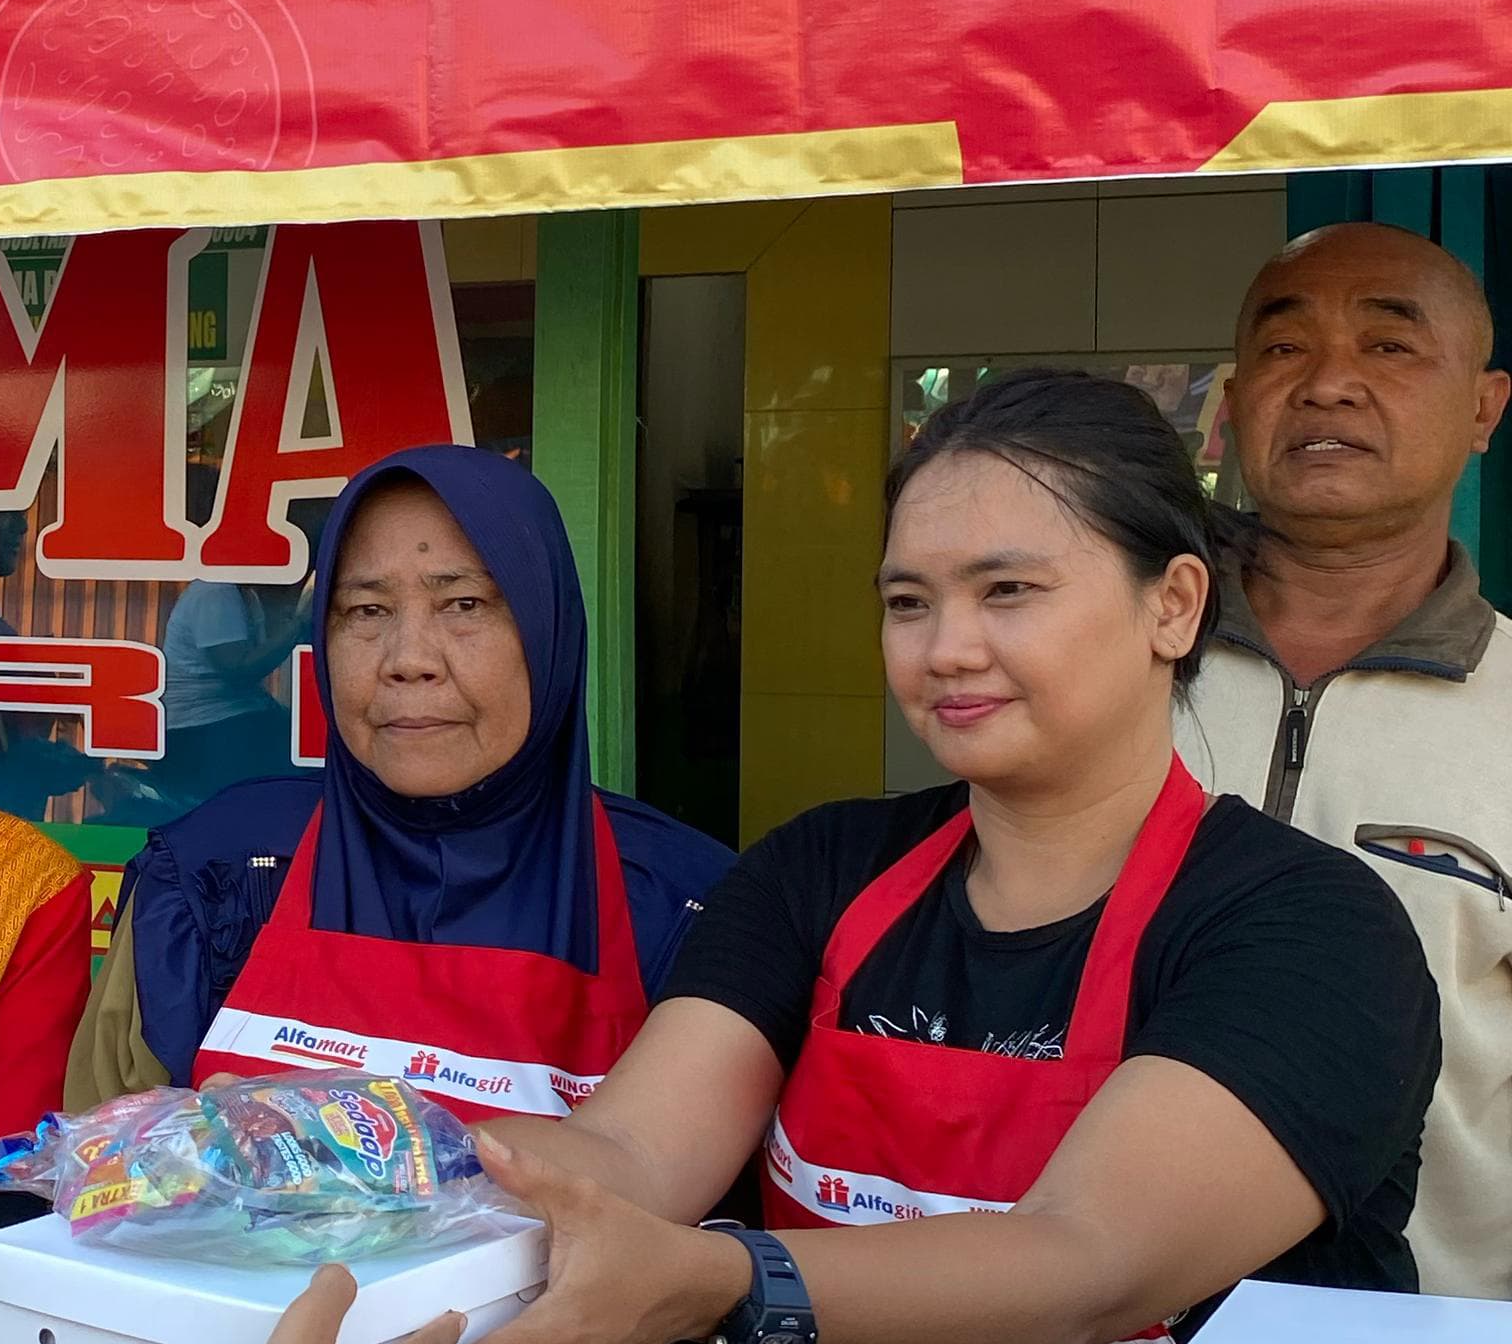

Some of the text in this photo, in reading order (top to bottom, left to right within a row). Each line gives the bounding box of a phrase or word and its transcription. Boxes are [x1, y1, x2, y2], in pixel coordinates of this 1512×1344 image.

[274, 1026, 369, 1060] Alfamart
[438, 1066, 513, 1095] Alfagift
[549, 1072, 601, 1095] WING
